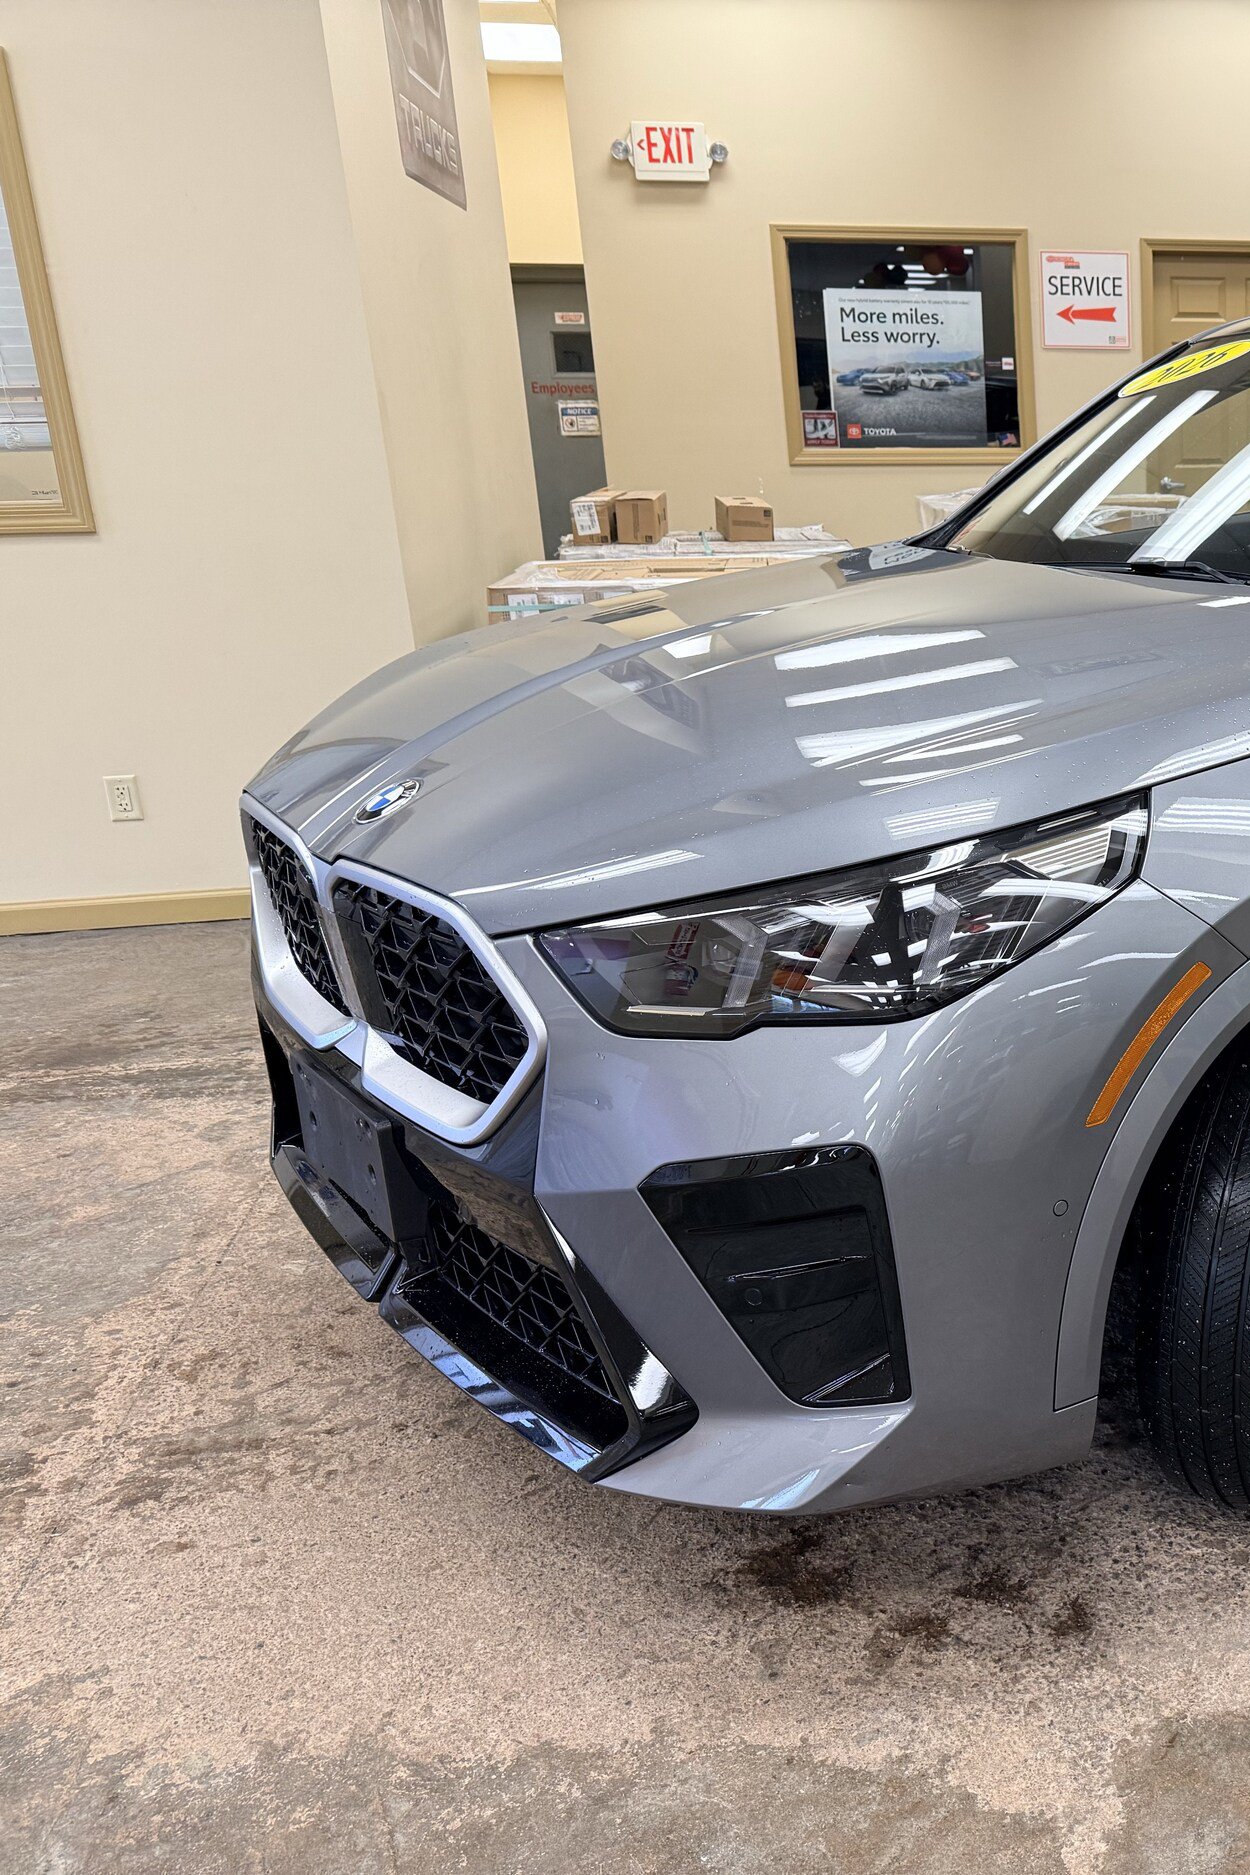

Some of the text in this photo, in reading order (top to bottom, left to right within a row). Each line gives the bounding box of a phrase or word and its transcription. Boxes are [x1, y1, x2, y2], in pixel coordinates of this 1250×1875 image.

[399, 93, 459, 177] TRUCKS
[645, 127, 695, 164] EXIT
[1048, 275, 1123, 297] SERVICE
[840, 307, 944, 325] More miles.
[841, 327, 940, 348] Less worry.
[1133, 342, 1244, 391] 2026
[531, 381, 595, 396] Employees
[863, 427, 897, 436] TOYOTA
